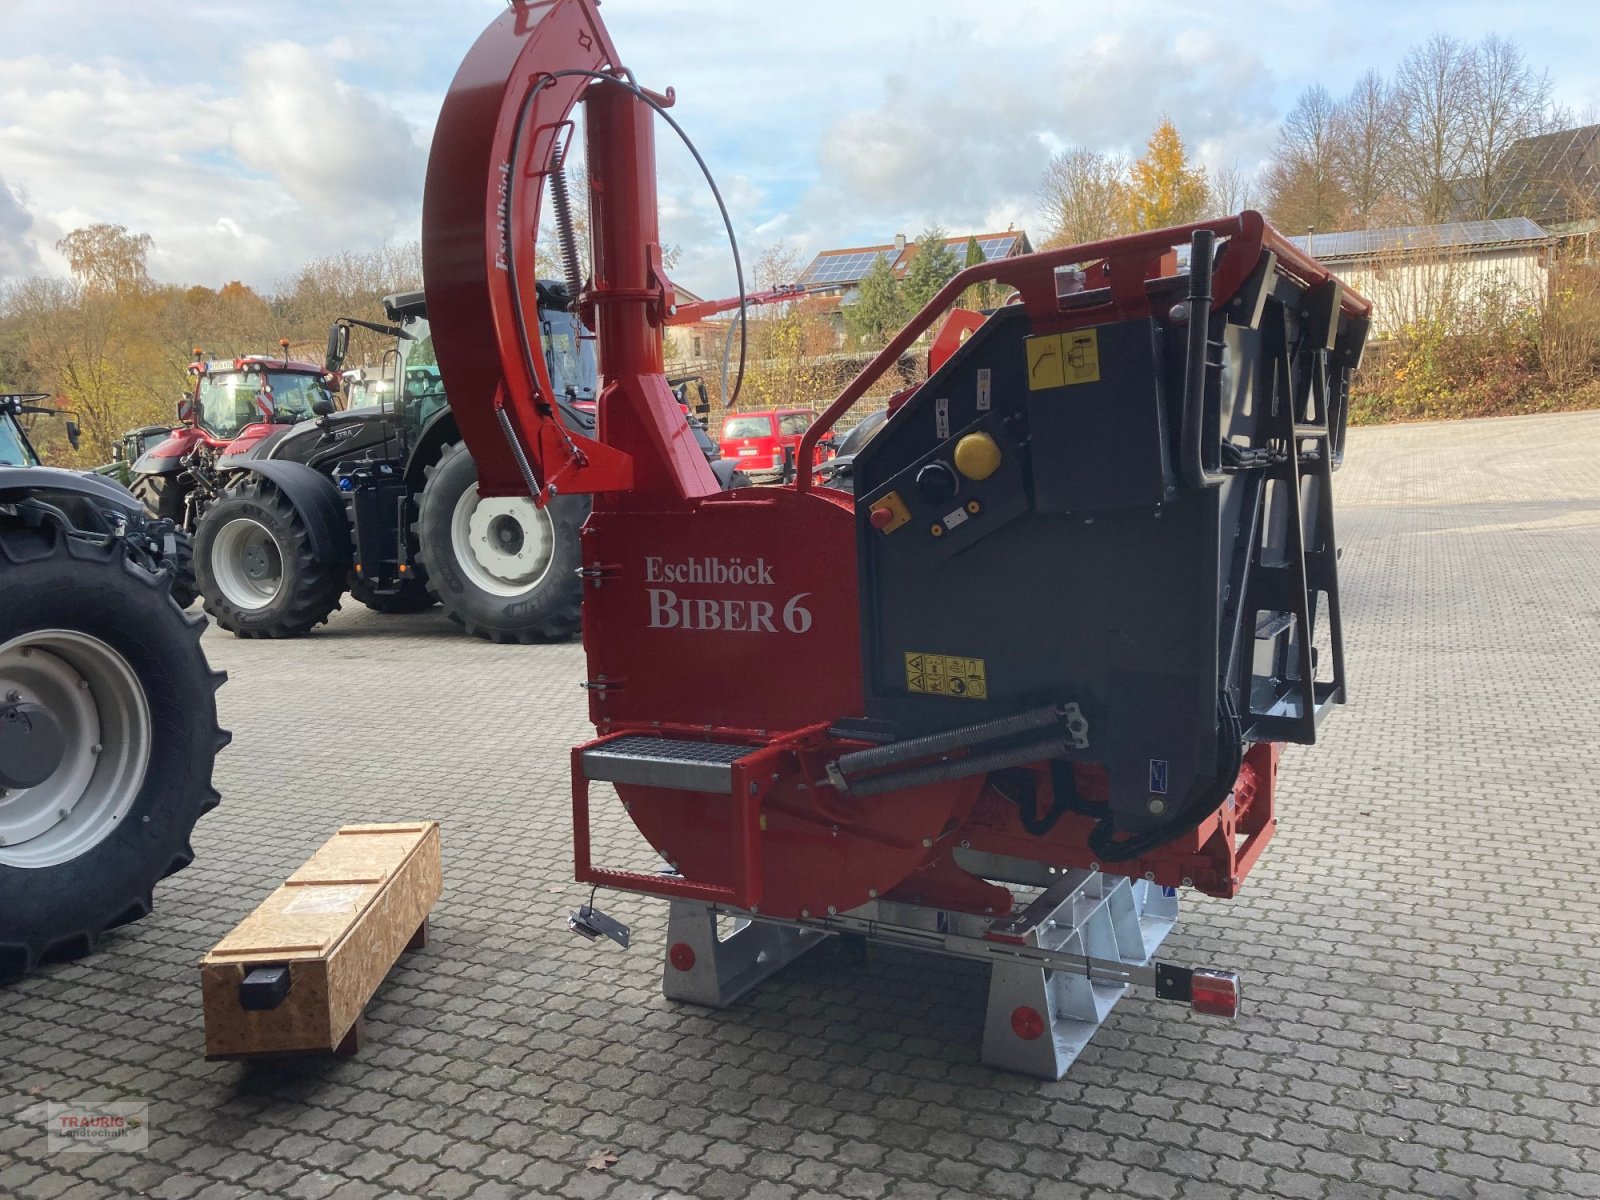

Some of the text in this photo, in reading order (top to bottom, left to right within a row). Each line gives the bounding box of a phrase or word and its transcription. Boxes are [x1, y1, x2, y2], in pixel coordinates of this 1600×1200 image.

[645, 556, 776, 585] Eschlböck
[645, 588, 812, 634] BIBER 6
